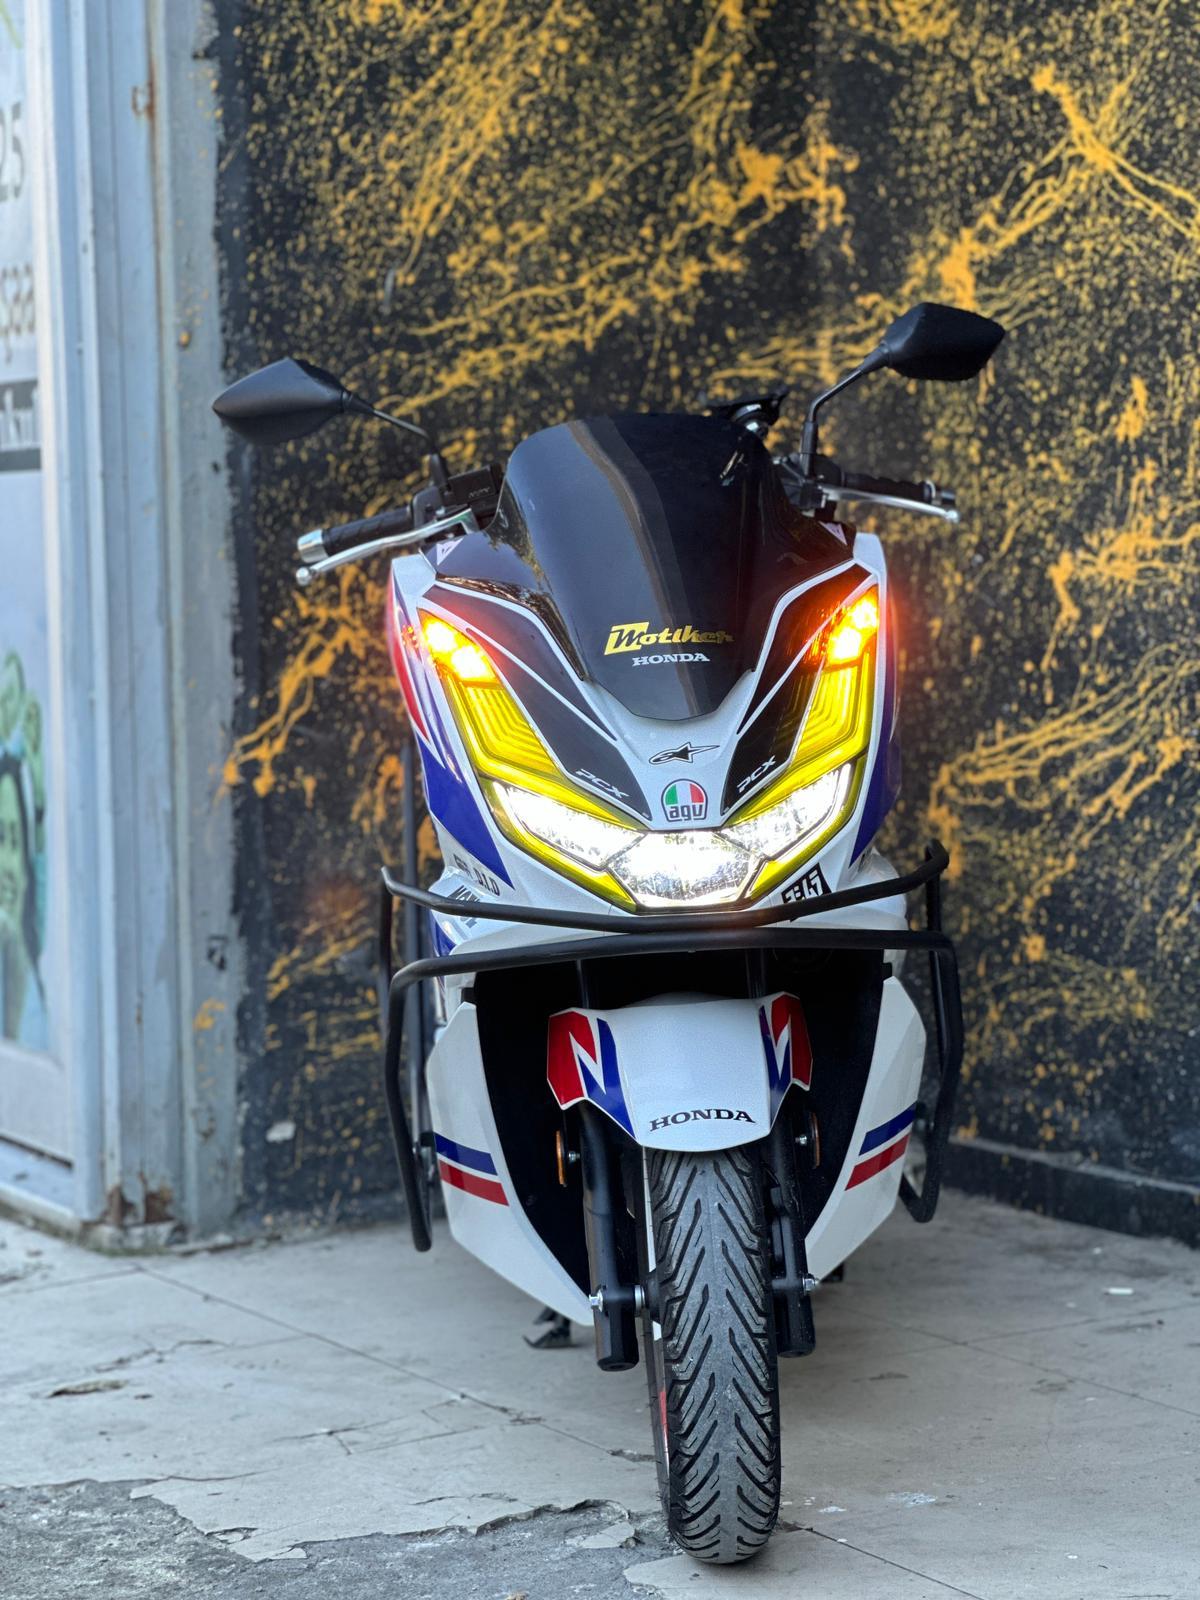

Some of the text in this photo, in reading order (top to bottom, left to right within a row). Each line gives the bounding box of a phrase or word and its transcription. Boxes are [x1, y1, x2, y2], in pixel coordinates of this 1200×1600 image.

[631, 652, 710, 667] HONDA
[575, 768, 630, 799] PCX
[735, 755, 776, 794] PCX
[668, 803, 704, 821] agv
[649, 1108, 756, 1132] HONDA
